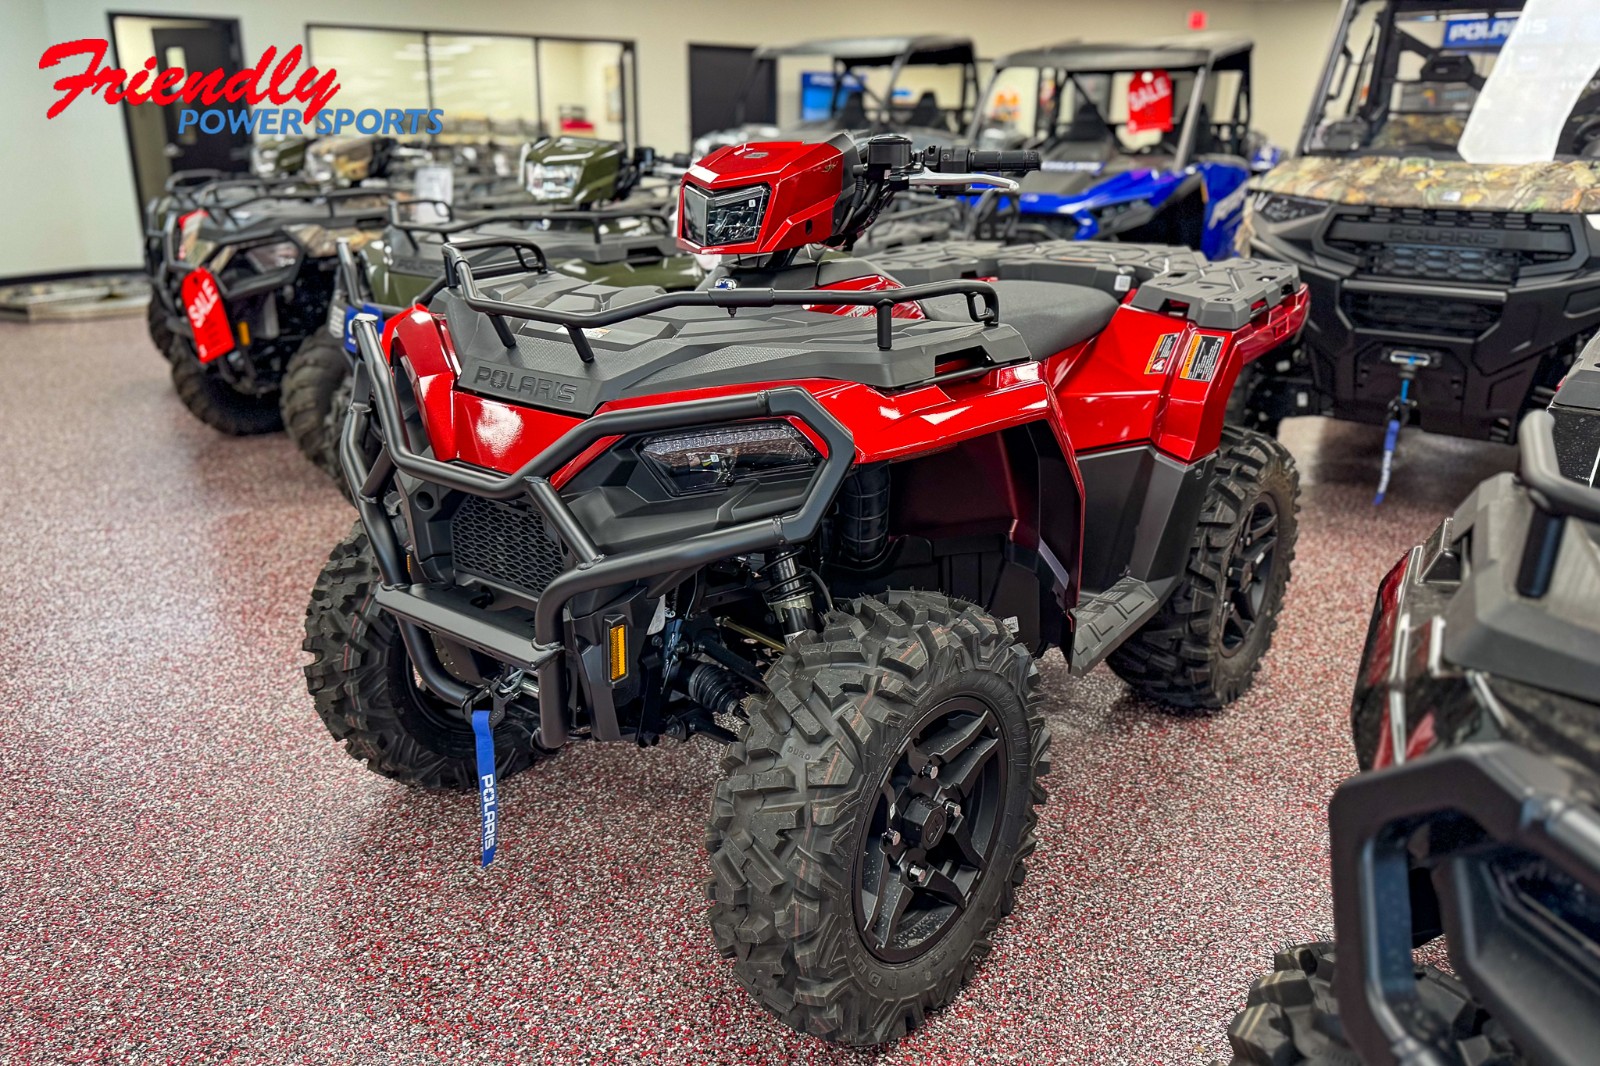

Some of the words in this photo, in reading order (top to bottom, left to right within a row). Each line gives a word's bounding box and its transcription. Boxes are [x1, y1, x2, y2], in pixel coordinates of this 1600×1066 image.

[1129, 76, 1171, 112] SALE
[188, 278, 219, 329] SALE
[473, 366, 577, 404] POLARIS
[481, 773, 496, 851] POLARIS
